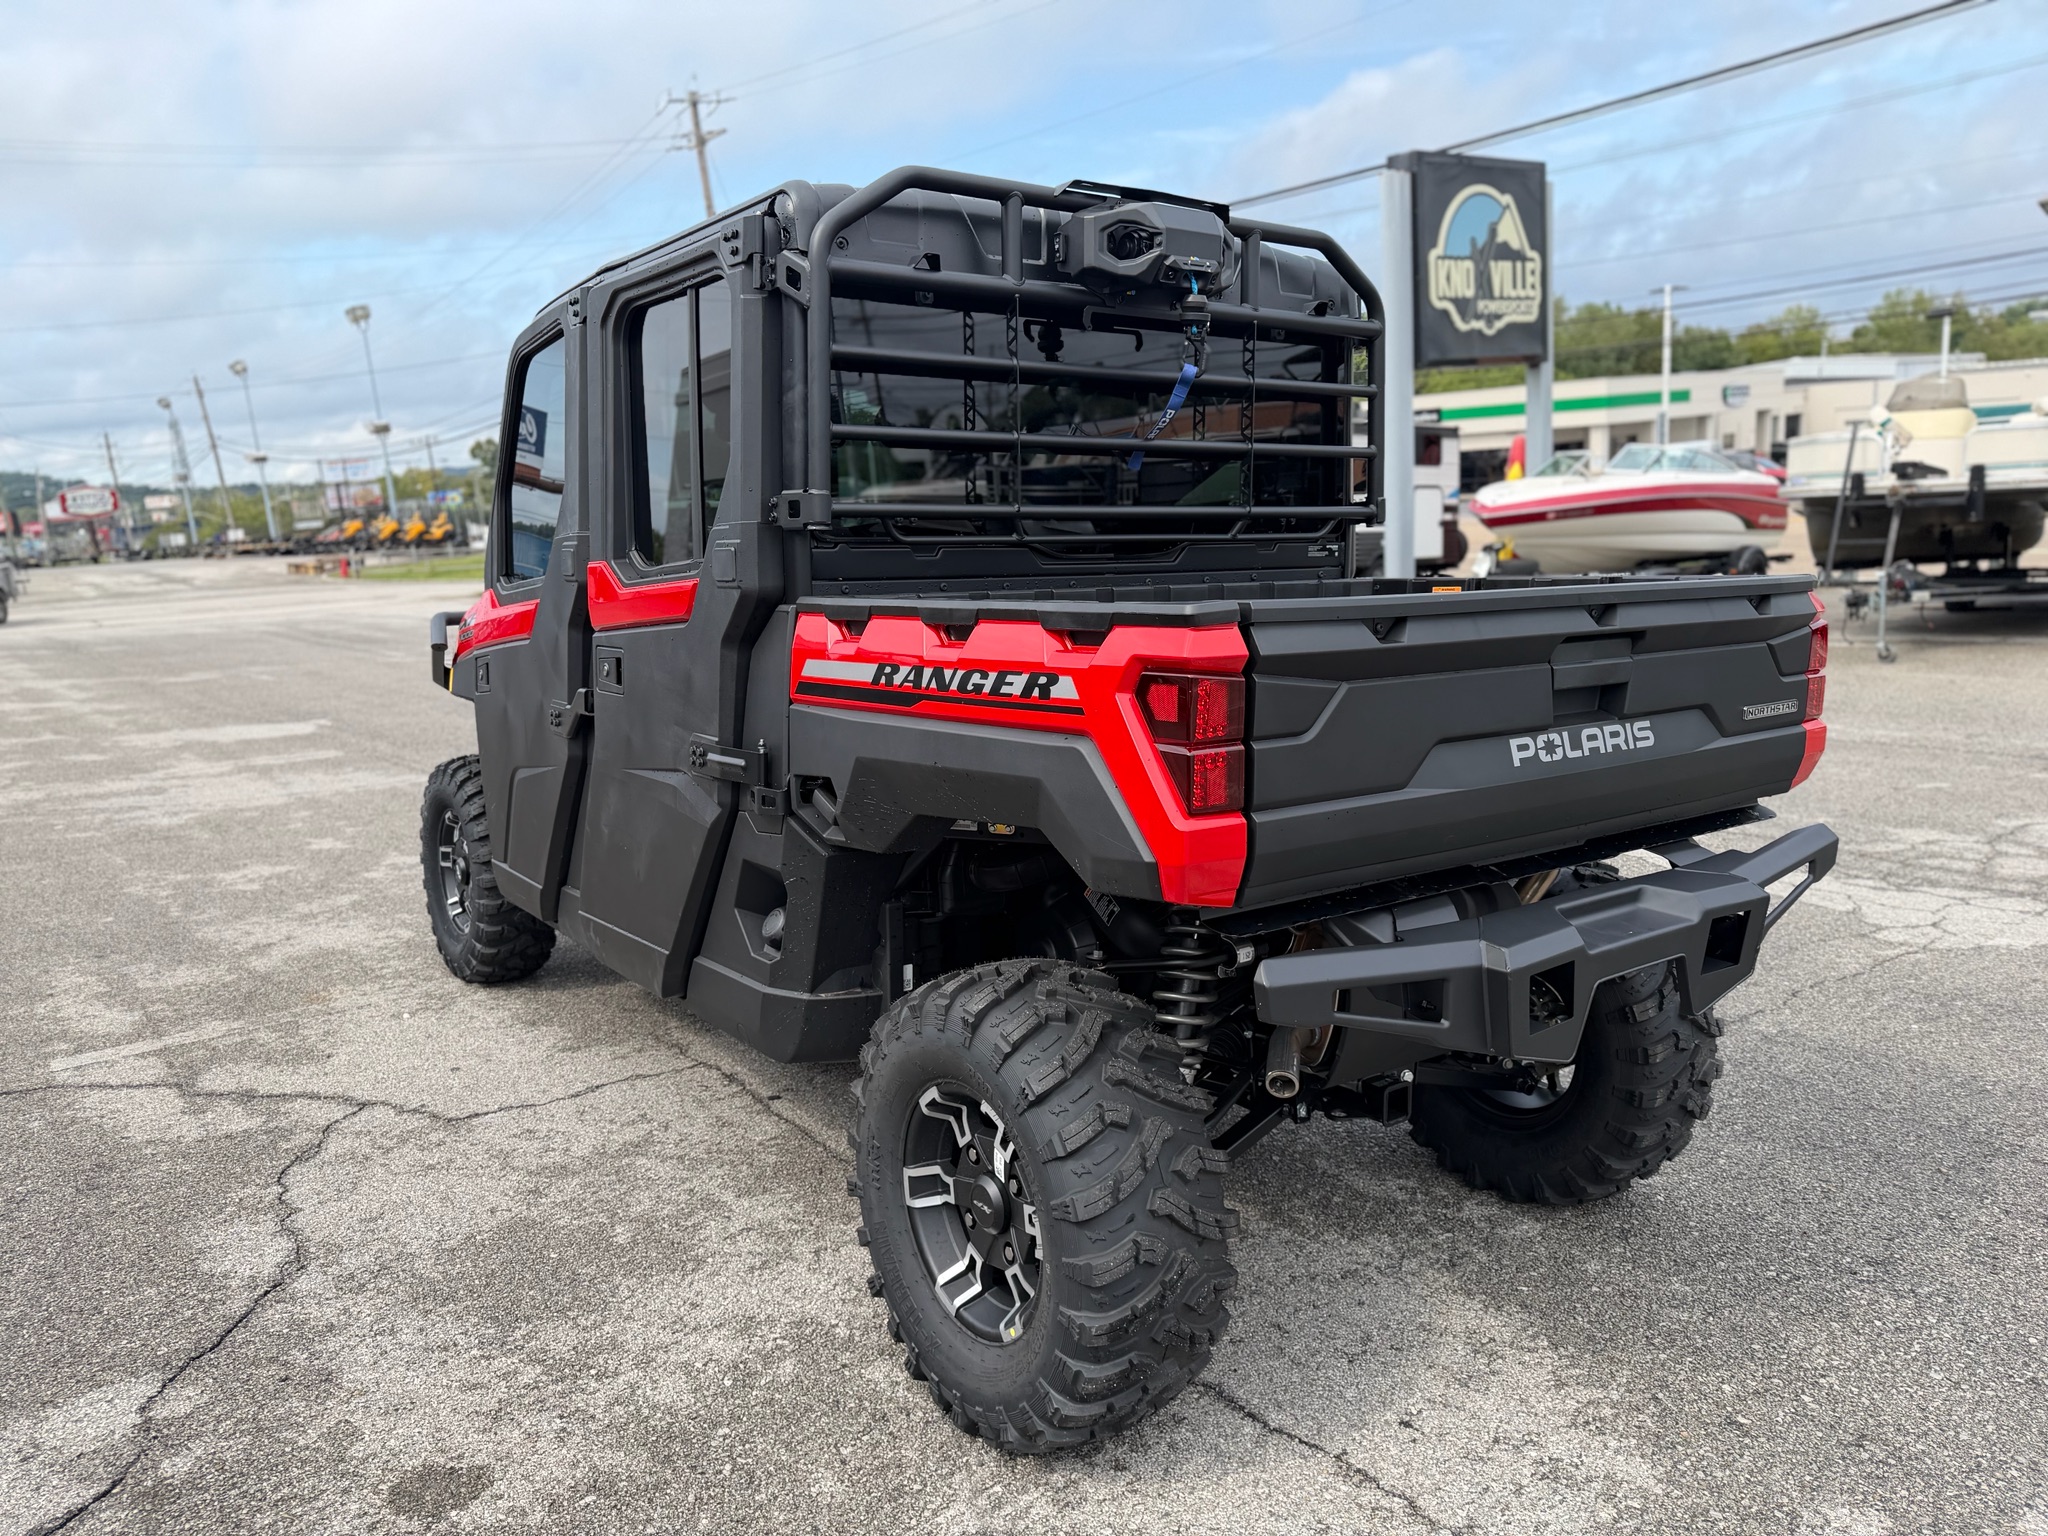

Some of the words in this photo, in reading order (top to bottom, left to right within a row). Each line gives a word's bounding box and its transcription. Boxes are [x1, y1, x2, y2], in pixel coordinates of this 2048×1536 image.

[870, 662, 1060, 701] RANGER
[1746, 701, 1798, 718] NORTHSTAR
[1509, 720, 1656, 767] POLARIS
[873, 1218, 944, 1362] X-TERRAIN
